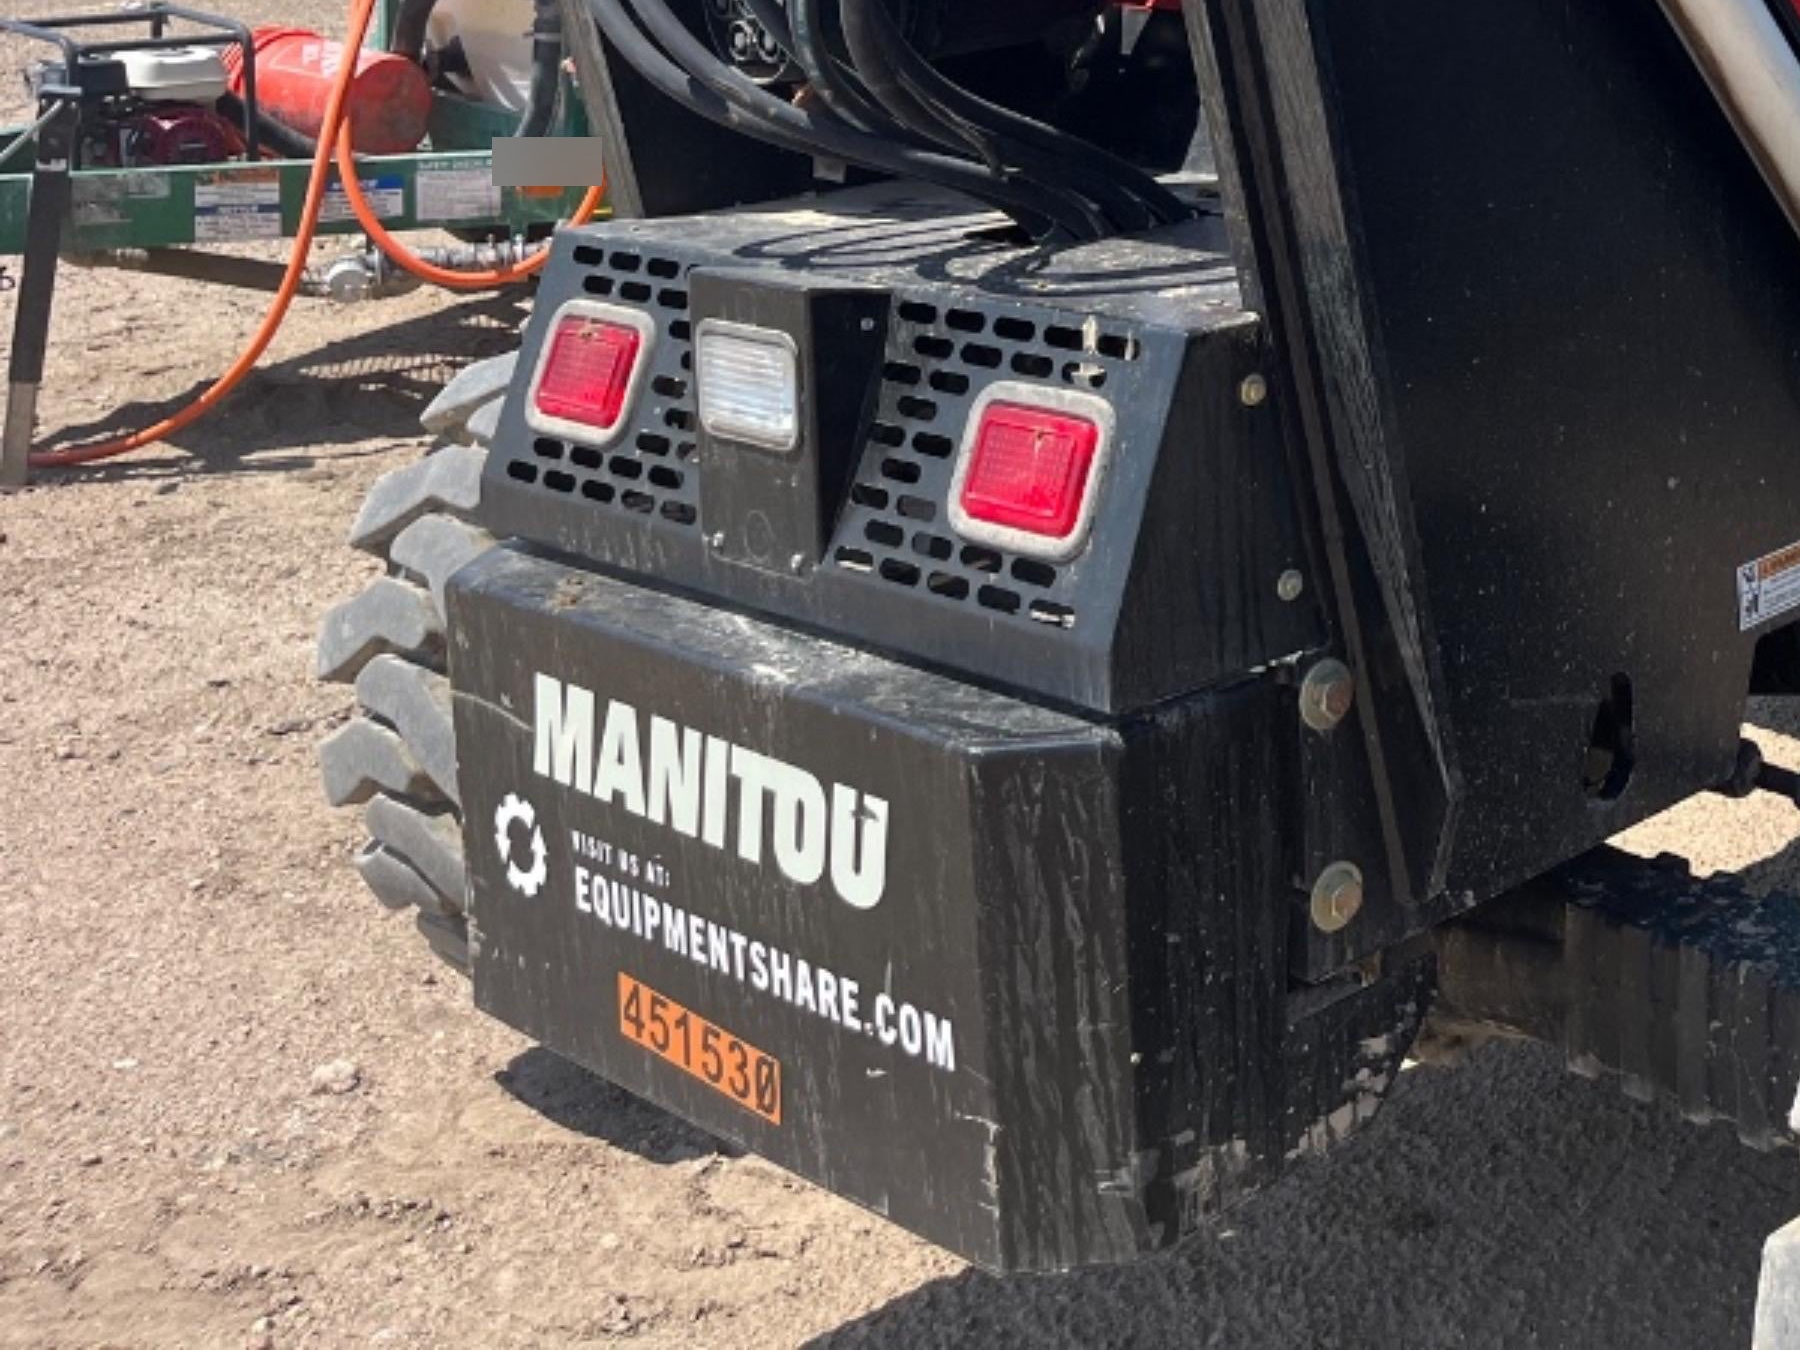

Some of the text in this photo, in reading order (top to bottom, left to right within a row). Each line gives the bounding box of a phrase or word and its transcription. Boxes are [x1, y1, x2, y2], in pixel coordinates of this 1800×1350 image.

[532, 672, 889, 910] MANITOU
[571, 830, 613, 865] VISIT
[618, 848, 641, 878] US
[575, 865, 957, 1073] EQUIPMENTSHARE.COM
[622, 982, 778, 1115] 451530
